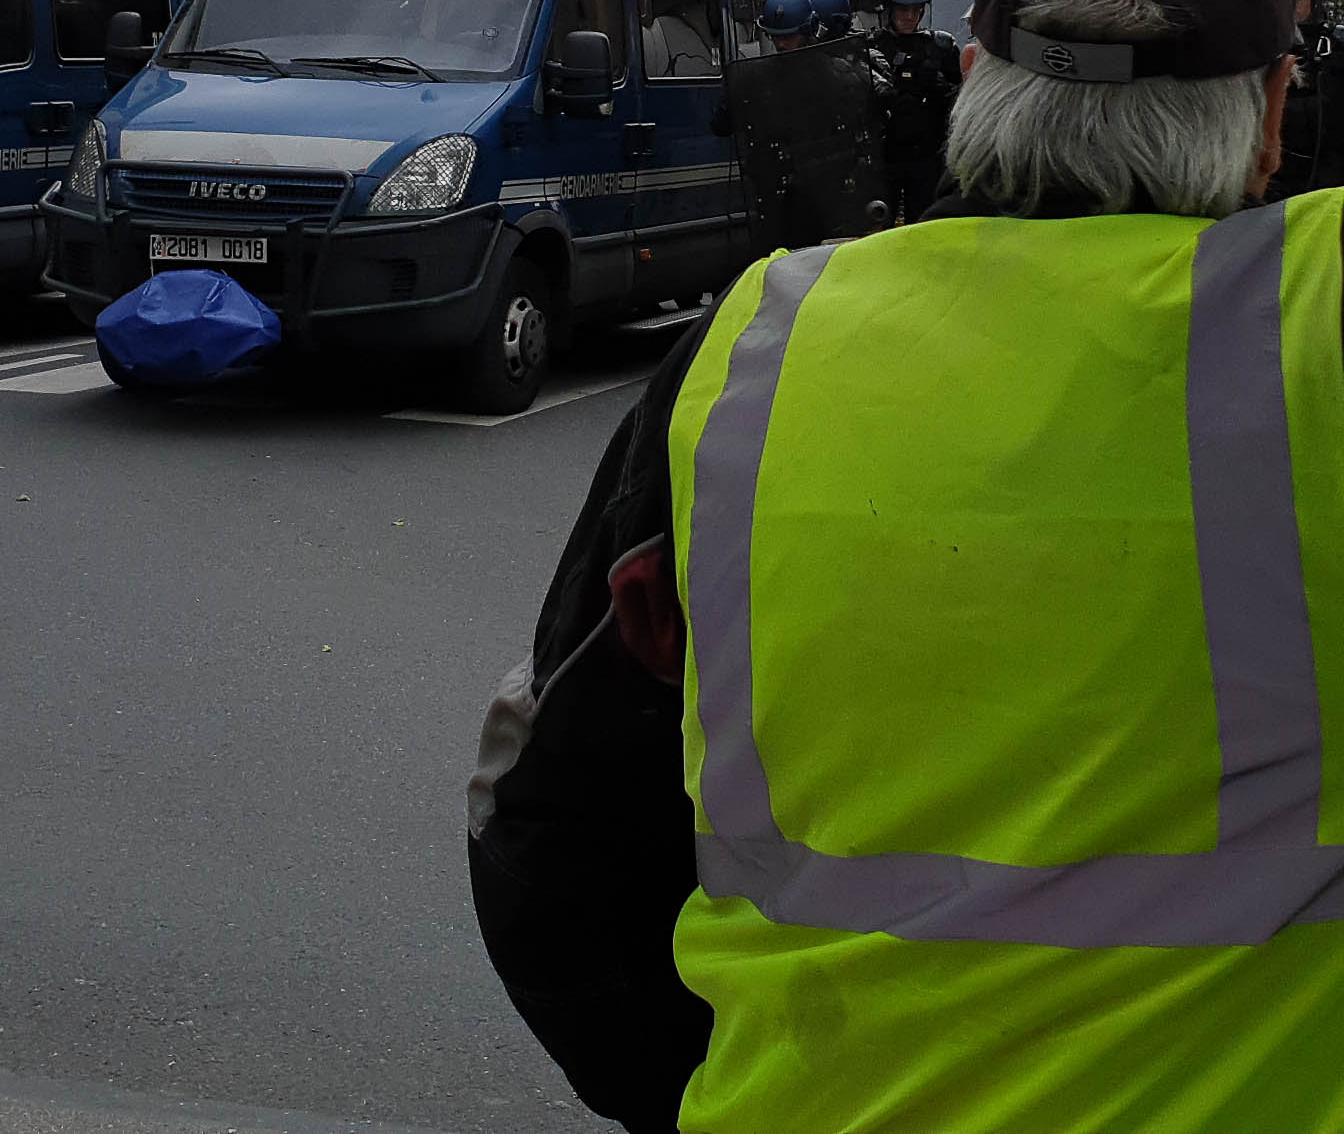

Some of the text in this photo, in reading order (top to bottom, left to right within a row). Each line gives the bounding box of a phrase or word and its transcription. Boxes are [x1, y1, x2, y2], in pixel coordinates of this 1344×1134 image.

[188, 181, 266, 201] IVECO
[560, 172, 623, 199] GENDARMERIE
[167, 237, 208, 259] 2081
